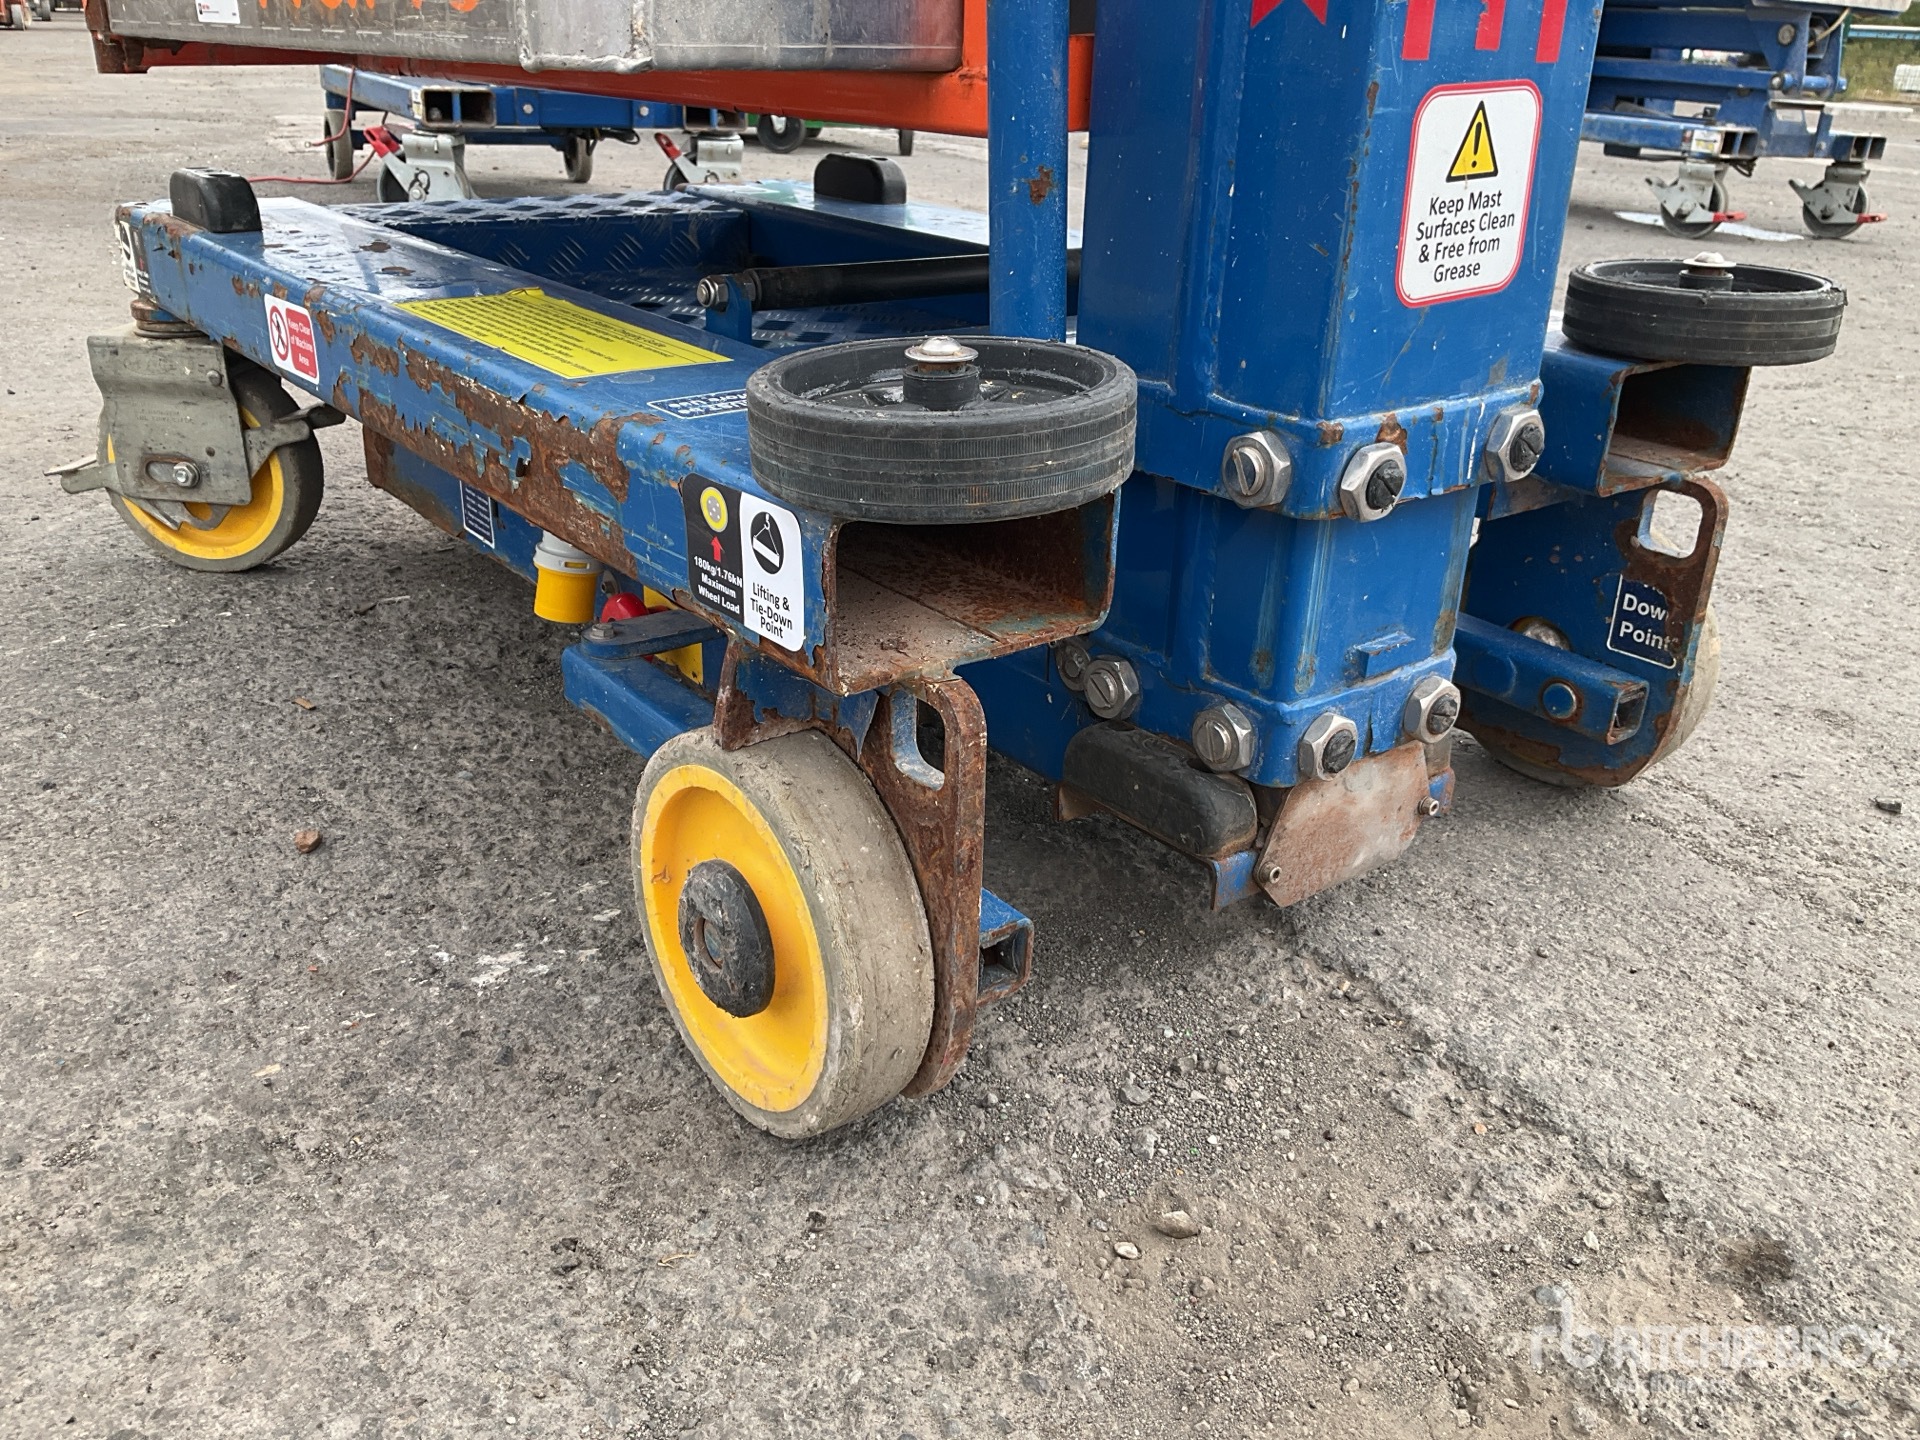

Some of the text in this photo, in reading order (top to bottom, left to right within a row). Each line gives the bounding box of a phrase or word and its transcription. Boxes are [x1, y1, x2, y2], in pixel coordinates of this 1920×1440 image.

[1429, 190, 1502, 218] Keep Mast
[1416, 212, 1515, 241] Surfaces Clean
[1418, 236, 1500, 263] & Free from
[1434, 262, 1481, 283] Grease
[698, 585, 740, 615] Wheel Load
[701, 573, 736, 599] Maximum
[752, 582, 791, 612] Lifting &
[750, 598, 793, 631] Tie-Down
[1622, 592, 1668, 621] Dow
[760, 616, 784, 639] Point
